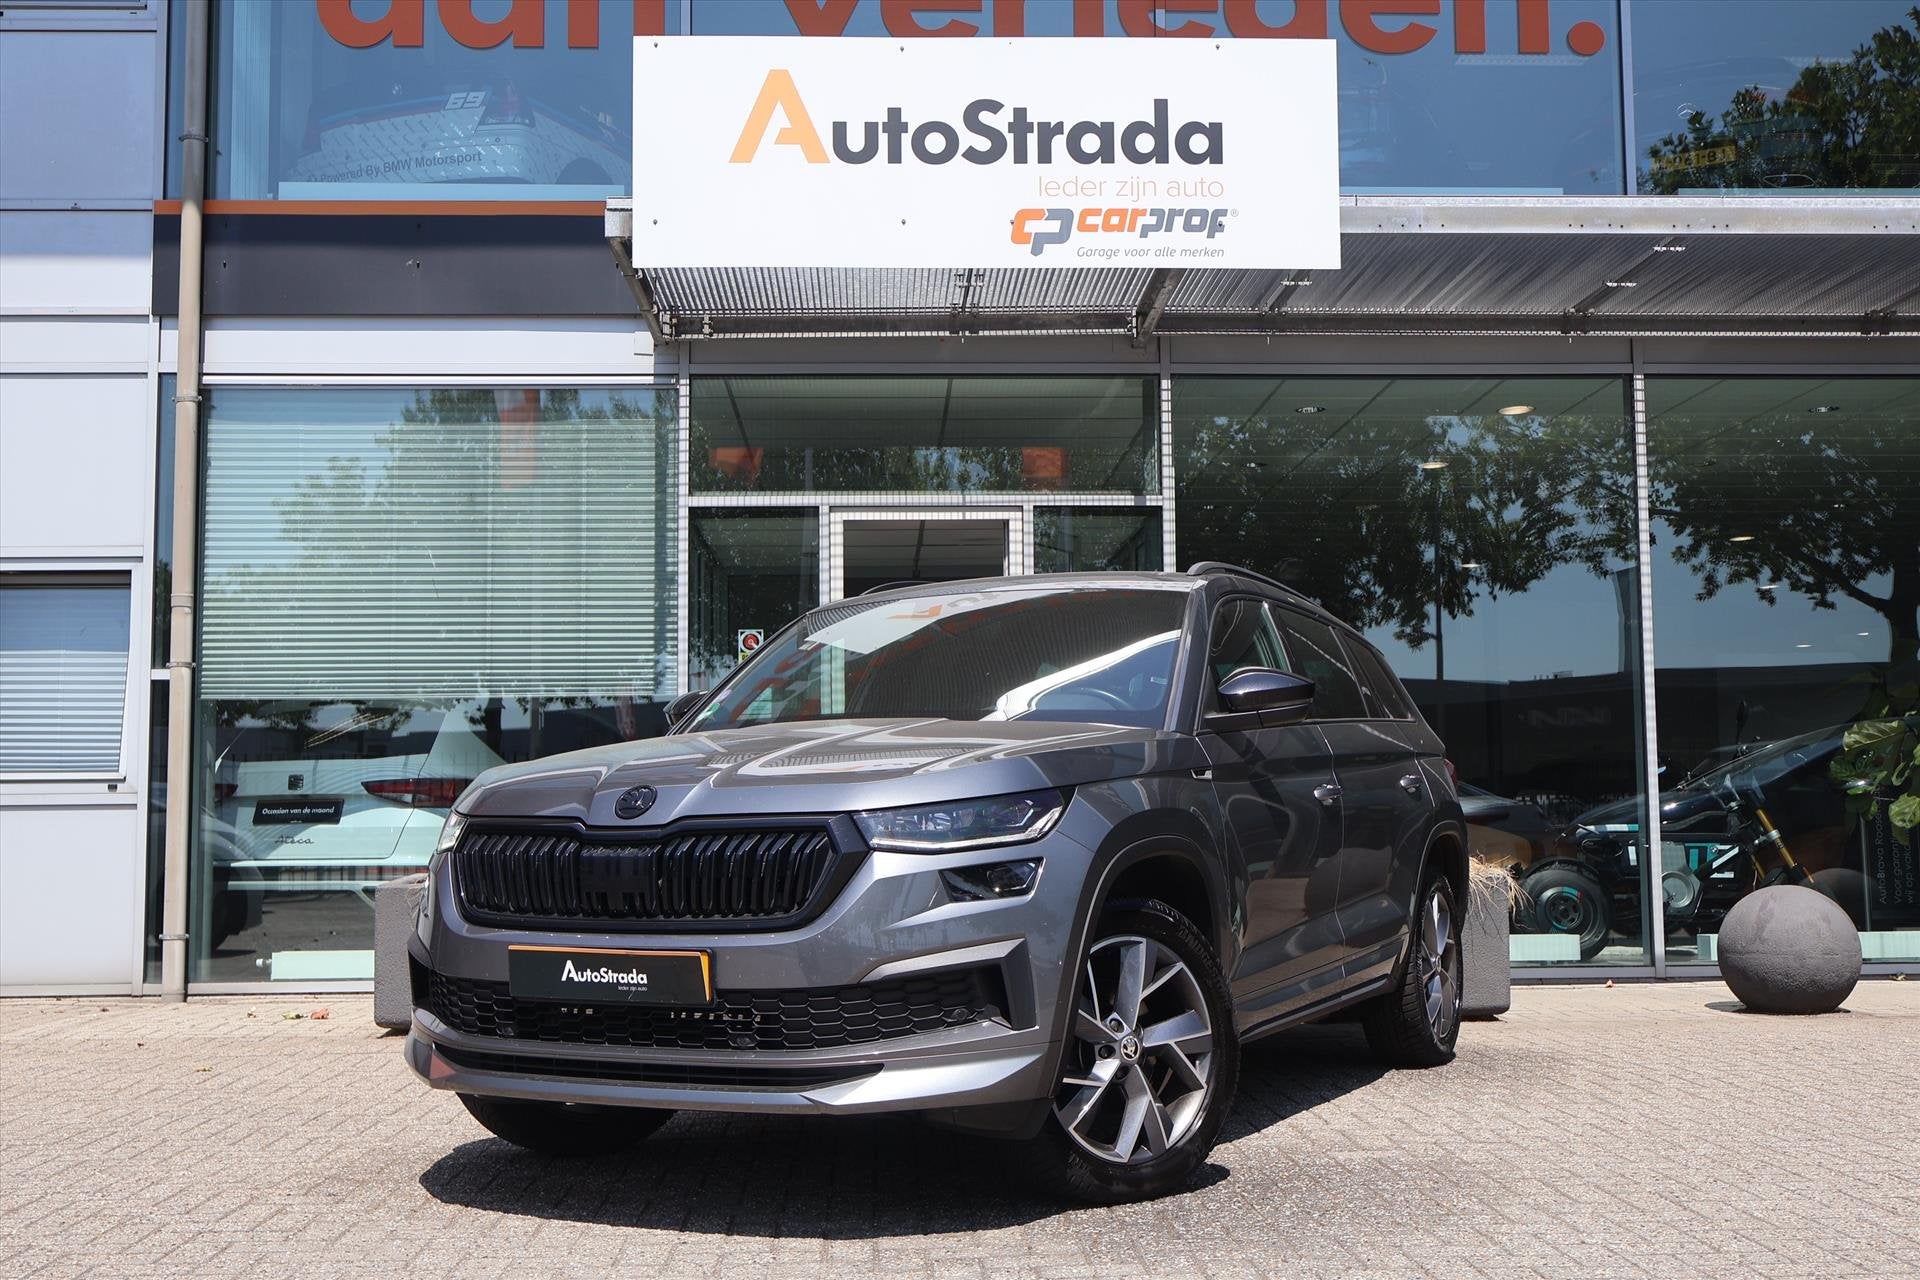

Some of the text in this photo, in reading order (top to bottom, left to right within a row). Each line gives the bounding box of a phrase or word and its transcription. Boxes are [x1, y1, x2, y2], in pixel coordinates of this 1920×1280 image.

[444, 91, 487, 111] 69
[728, 68, 1225, 167] AutoStrada
[366, 165, 380, 178] By
[383, 158, 413, 174] BMW
[415, 151, 483, 169] Motorsport
[1038, 175, 1225, 203] Ieder zijn auto
[1076, 246, 1225, 260] Garage voor alle merken
[262, 807, 289, 815] Occasion
[302, 806, 310, 814] de
[311, 806, 335, 814] maand
[274, 834, 315, 846] Ateca
[561, 959, 648, 985] AutoStrada
